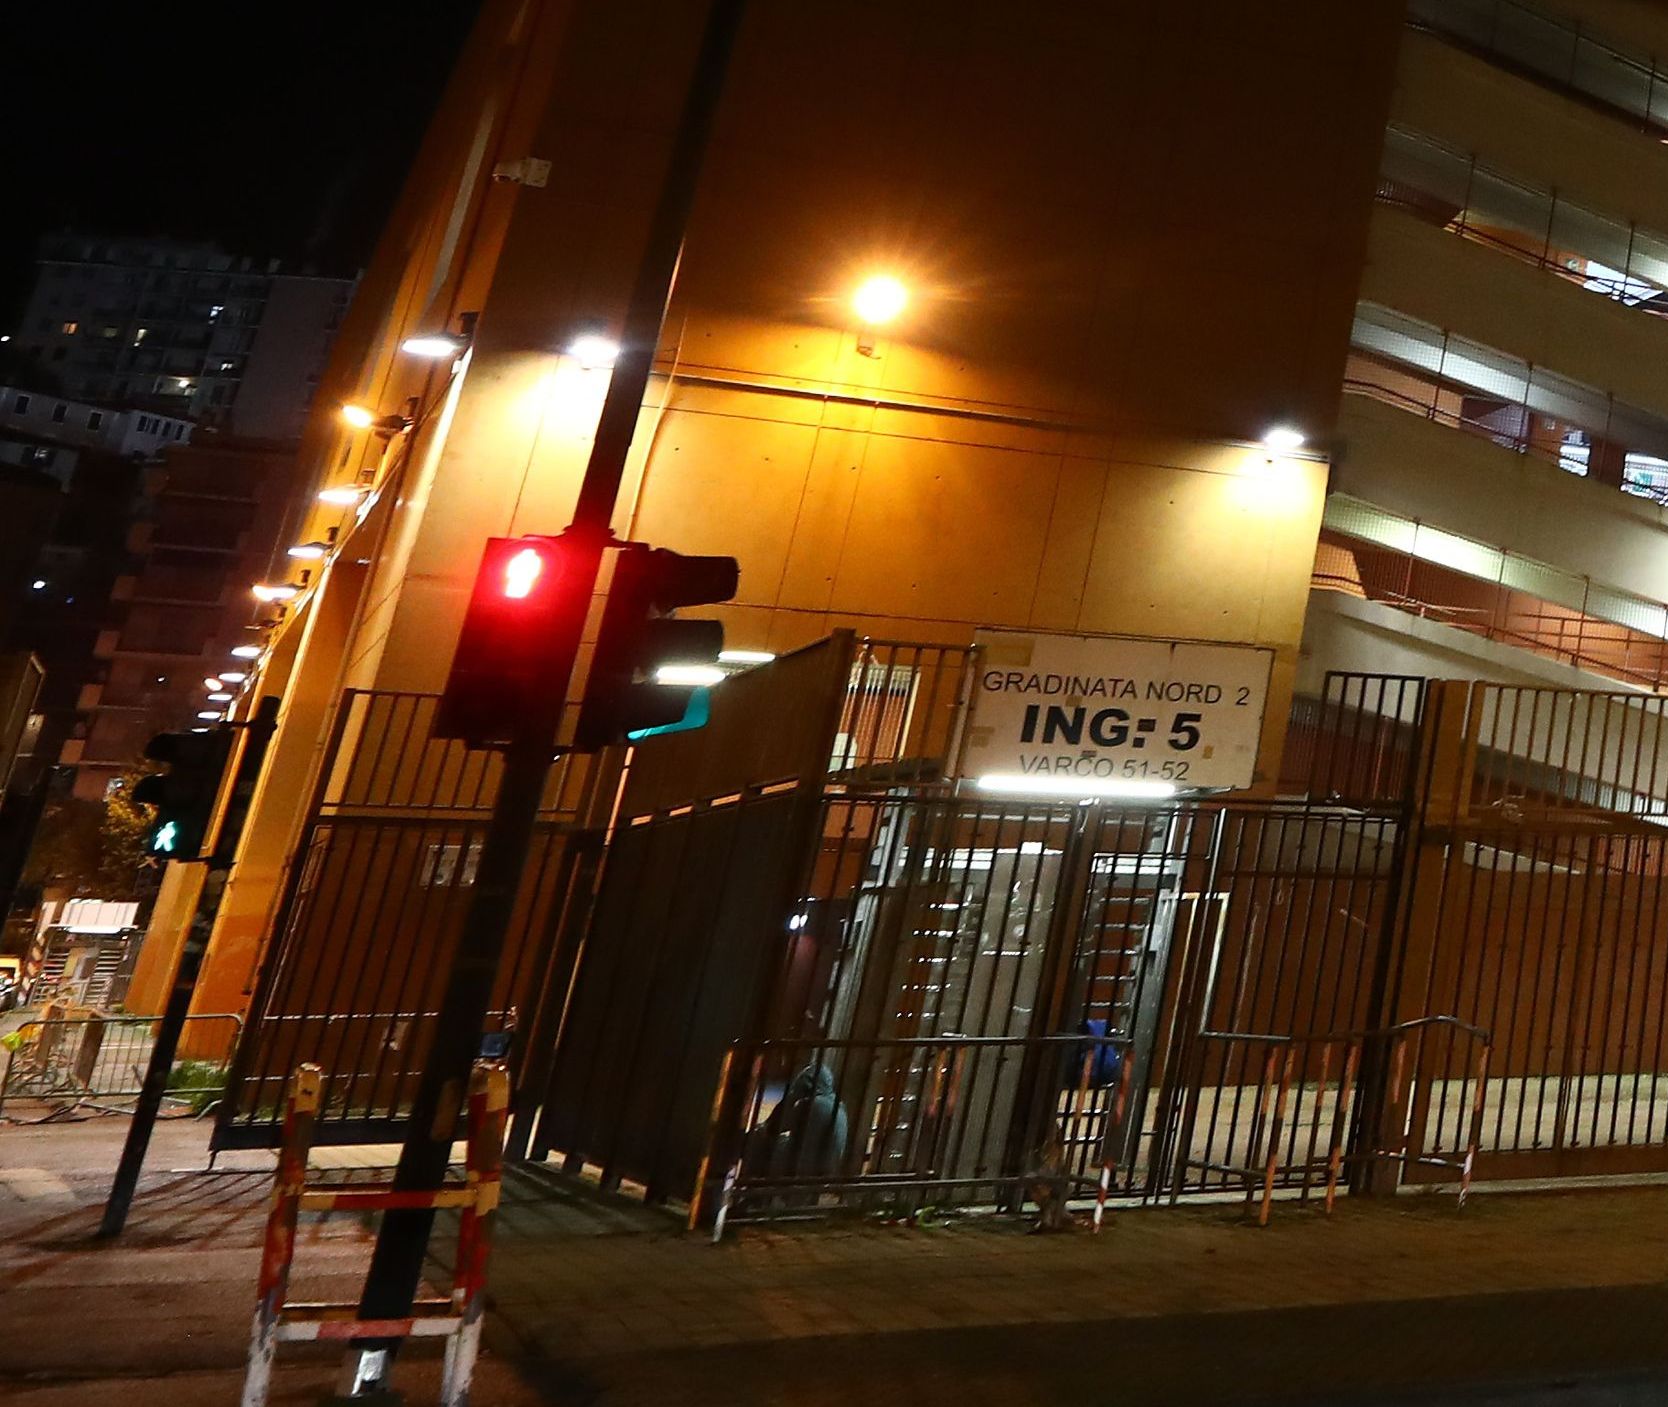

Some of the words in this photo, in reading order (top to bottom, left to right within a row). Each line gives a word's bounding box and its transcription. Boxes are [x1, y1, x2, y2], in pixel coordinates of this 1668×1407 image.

[983, 671, 1138, 699] GRADINATA
[1146, 681, 1222, 705] NORD
[1235, 687, 1249, 706] 2
[1168, 713, 1202, 750] 5
[1019, 754, 1114, 778] VARCO
[1121, 759, 1190, 781] 51-52
